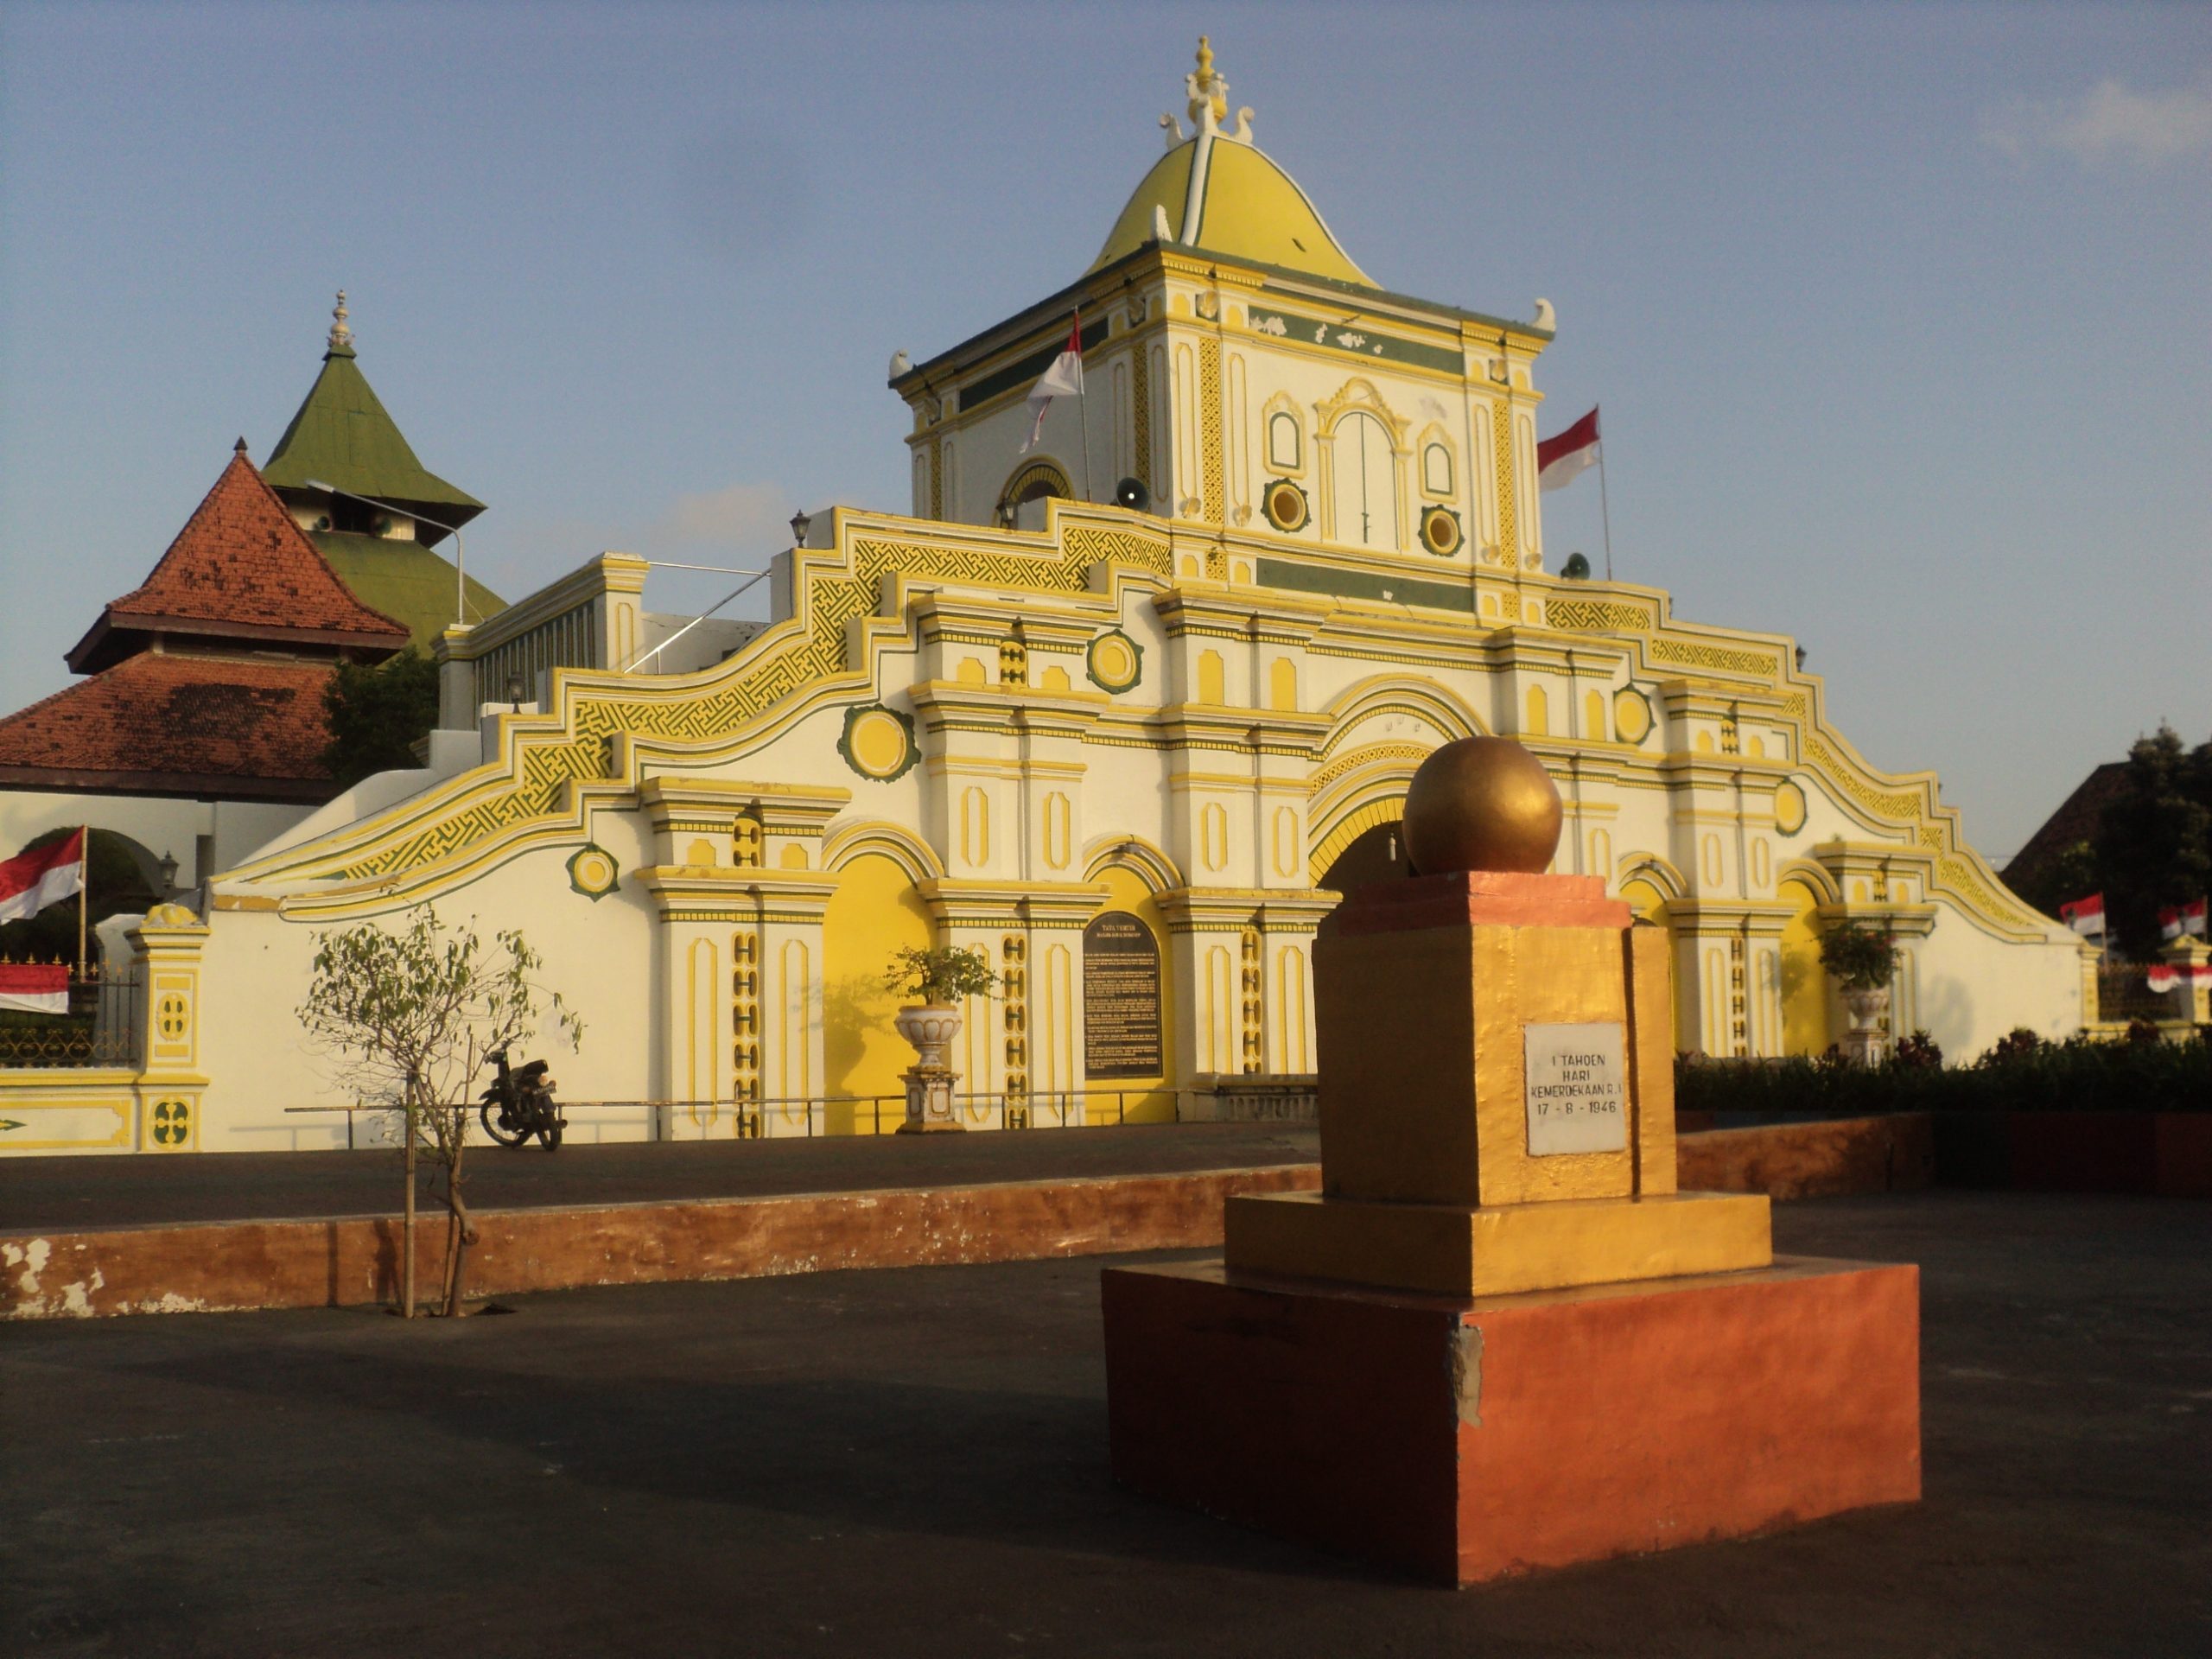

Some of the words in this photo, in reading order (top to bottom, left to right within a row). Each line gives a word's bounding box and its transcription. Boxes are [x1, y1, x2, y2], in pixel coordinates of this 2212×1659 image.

[1561, 1054, 1605, 1066] TAHOEN
[1563, 1070, 1590, 1082] HARI
[1531, 1084, 1605, 1098] KEMERDEKAAN
